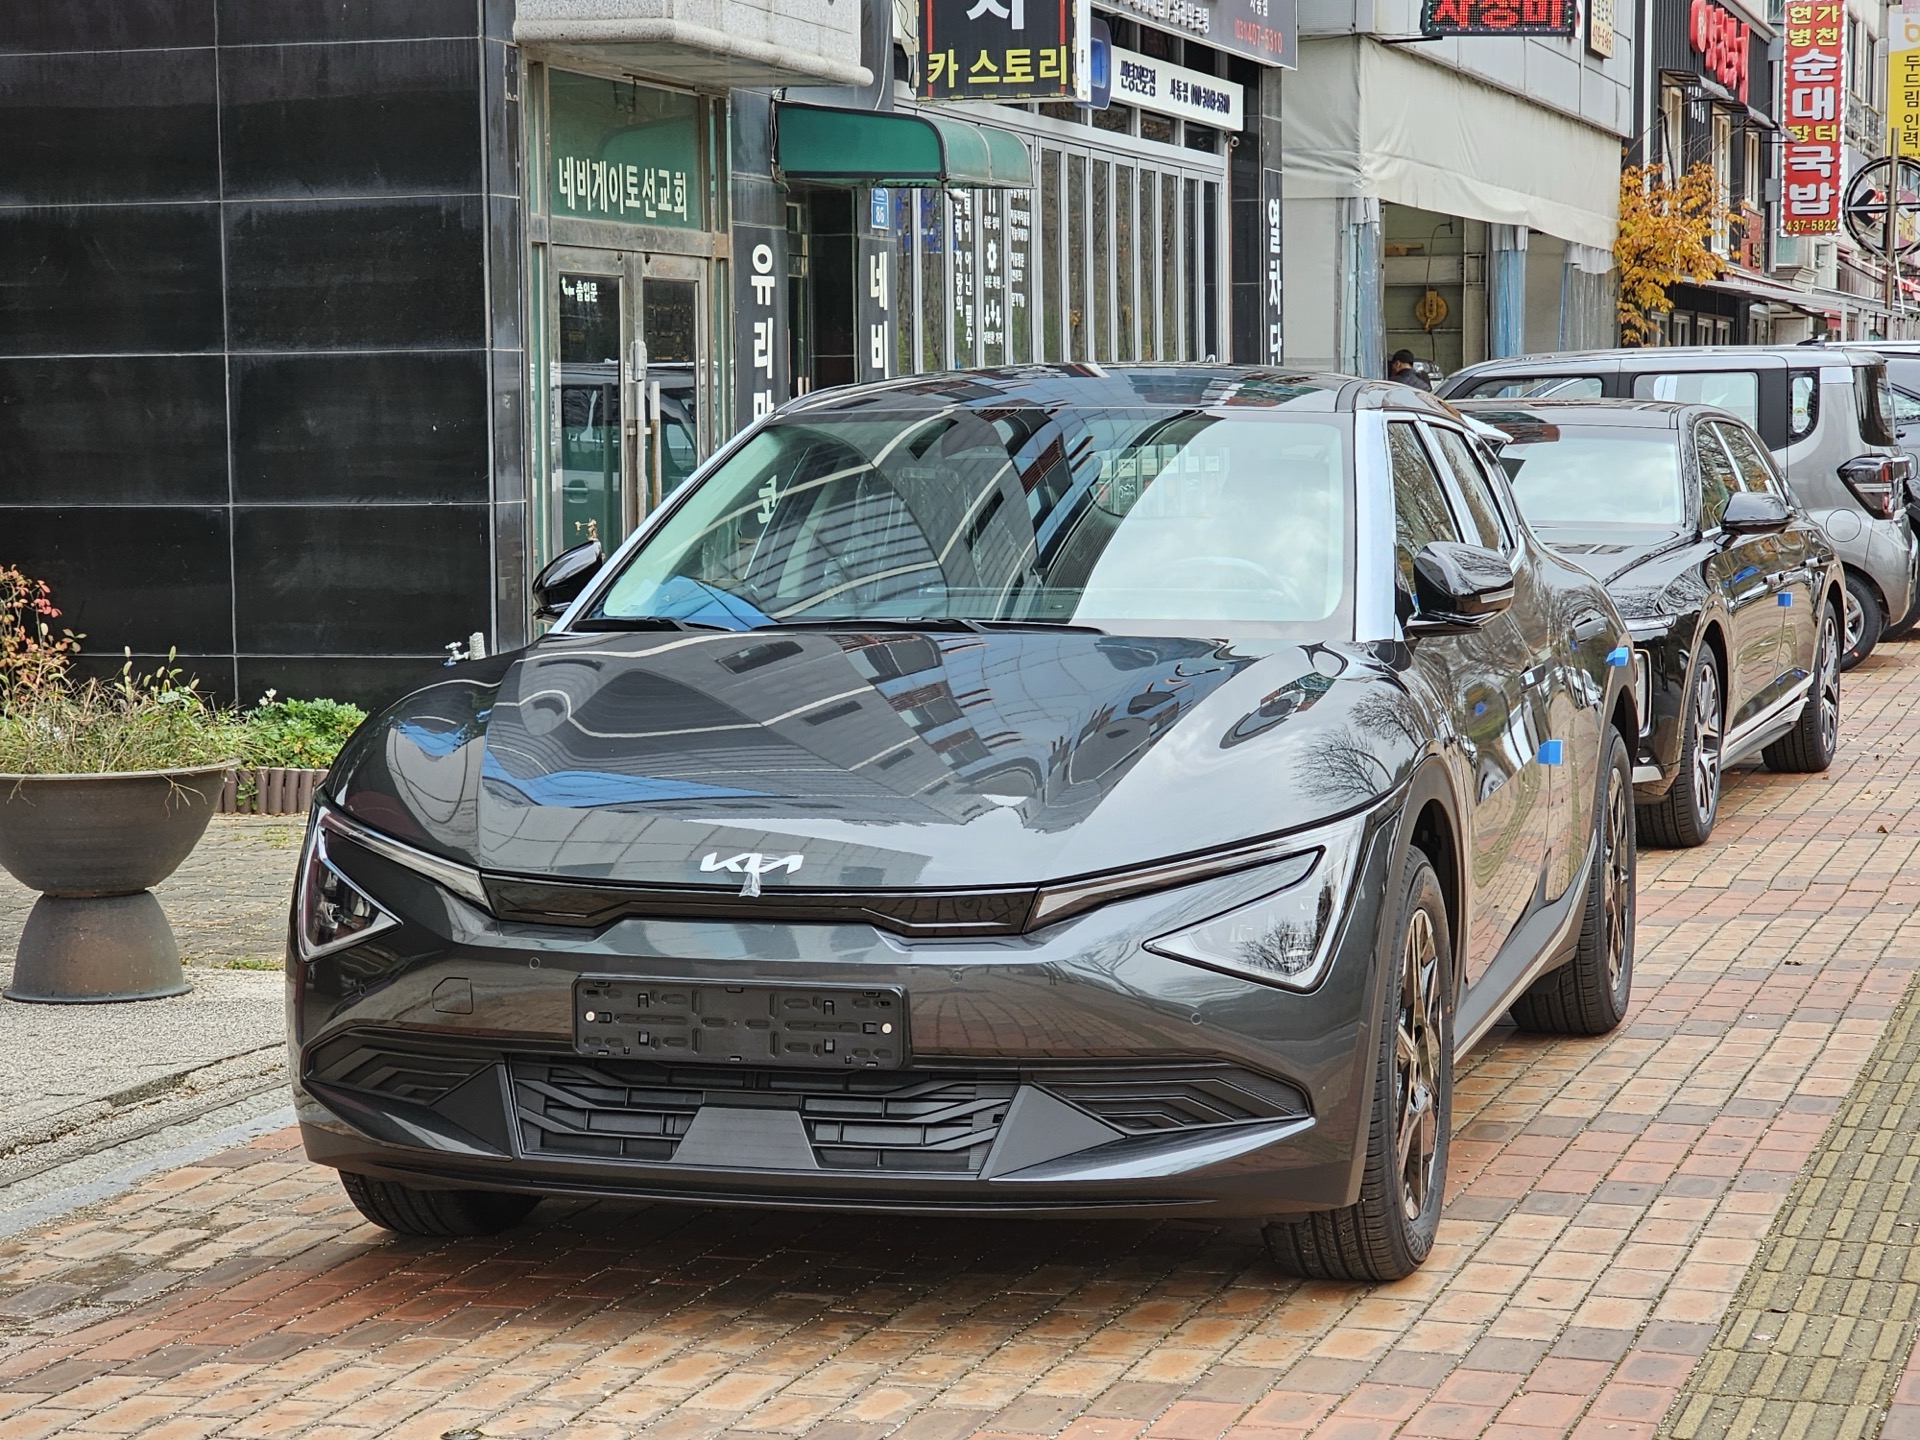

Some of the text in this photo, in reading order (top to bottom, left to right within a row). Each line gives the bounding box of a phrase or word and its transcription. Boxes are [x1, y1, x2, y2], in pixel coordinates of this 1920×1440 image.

[1789, 5, 1841, 25] 현가
[1788, 27, 1838, 47] 병천
[1903, 54, 1920, 108] 두드림
[1787, 124, 1837, 143] 장터
[1903, 113, 1920, 149] 인력
[558, 156, 688, 222] 네비게이토선교회
[1785, 219, 1838, 232] 437-5822
[575, 280, 598, 302] 출입문
